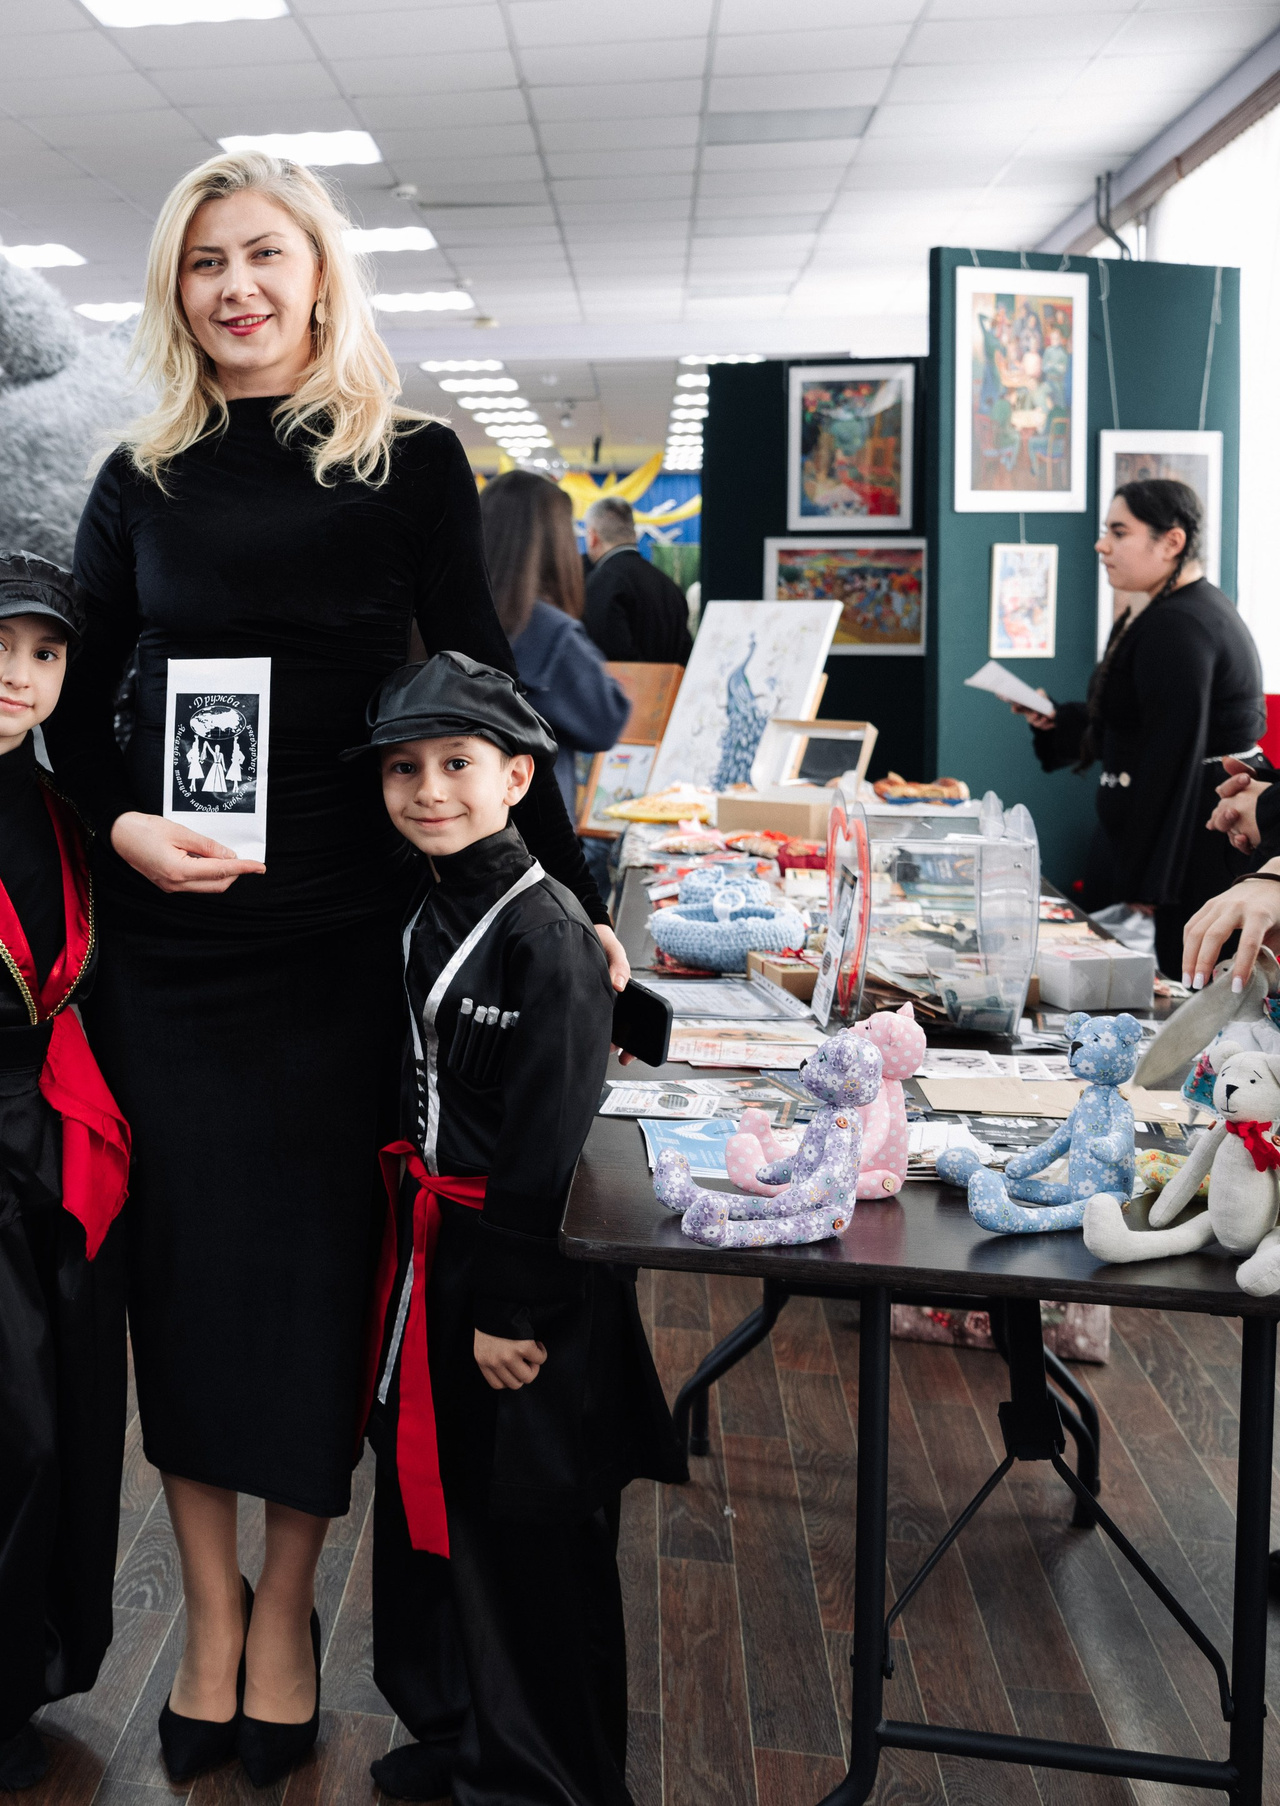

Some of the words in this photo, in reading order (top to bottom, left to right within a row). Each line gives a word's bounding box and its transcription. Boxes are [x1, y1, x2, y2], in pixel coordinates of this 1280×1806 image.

[193, 695, 240, 708] Дружба
[173, 724, 185, 766] Ансамбль
[246, 725, 257, 773] Закавказья
[174, 769, 191, 798] танцев
[222, 784, 249, 811] Кавказа
[189, 798, 220, 813] народов
